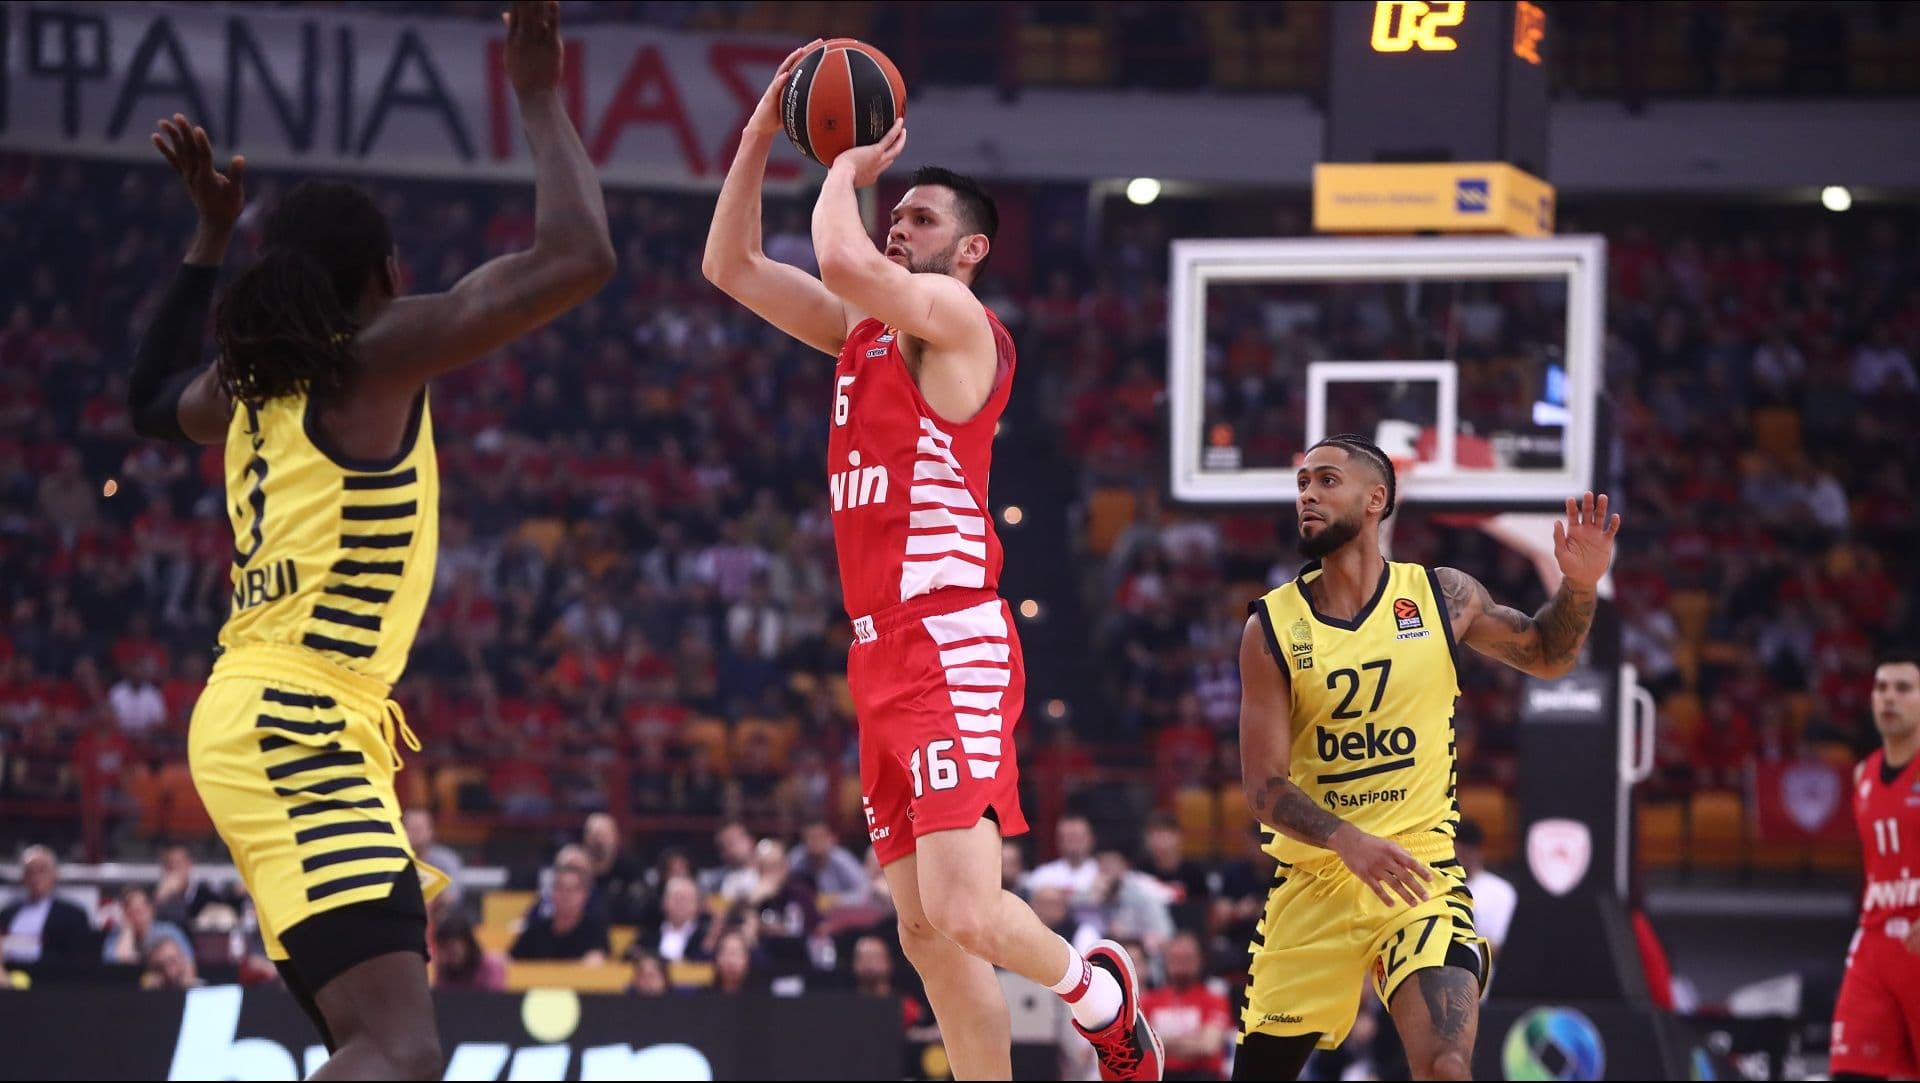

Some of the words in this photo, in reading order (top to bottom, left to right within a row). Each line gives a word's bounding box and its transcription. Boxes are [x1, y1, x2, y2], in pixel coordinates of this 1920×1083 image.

[1326, 658, 1392, 720] 27
[910, 739, 960, 799] 16
[1316, 723, 1416, 762] beko
[1874, 817, 1899, 857] 11
[1382, 915, 1439, 977] 27
